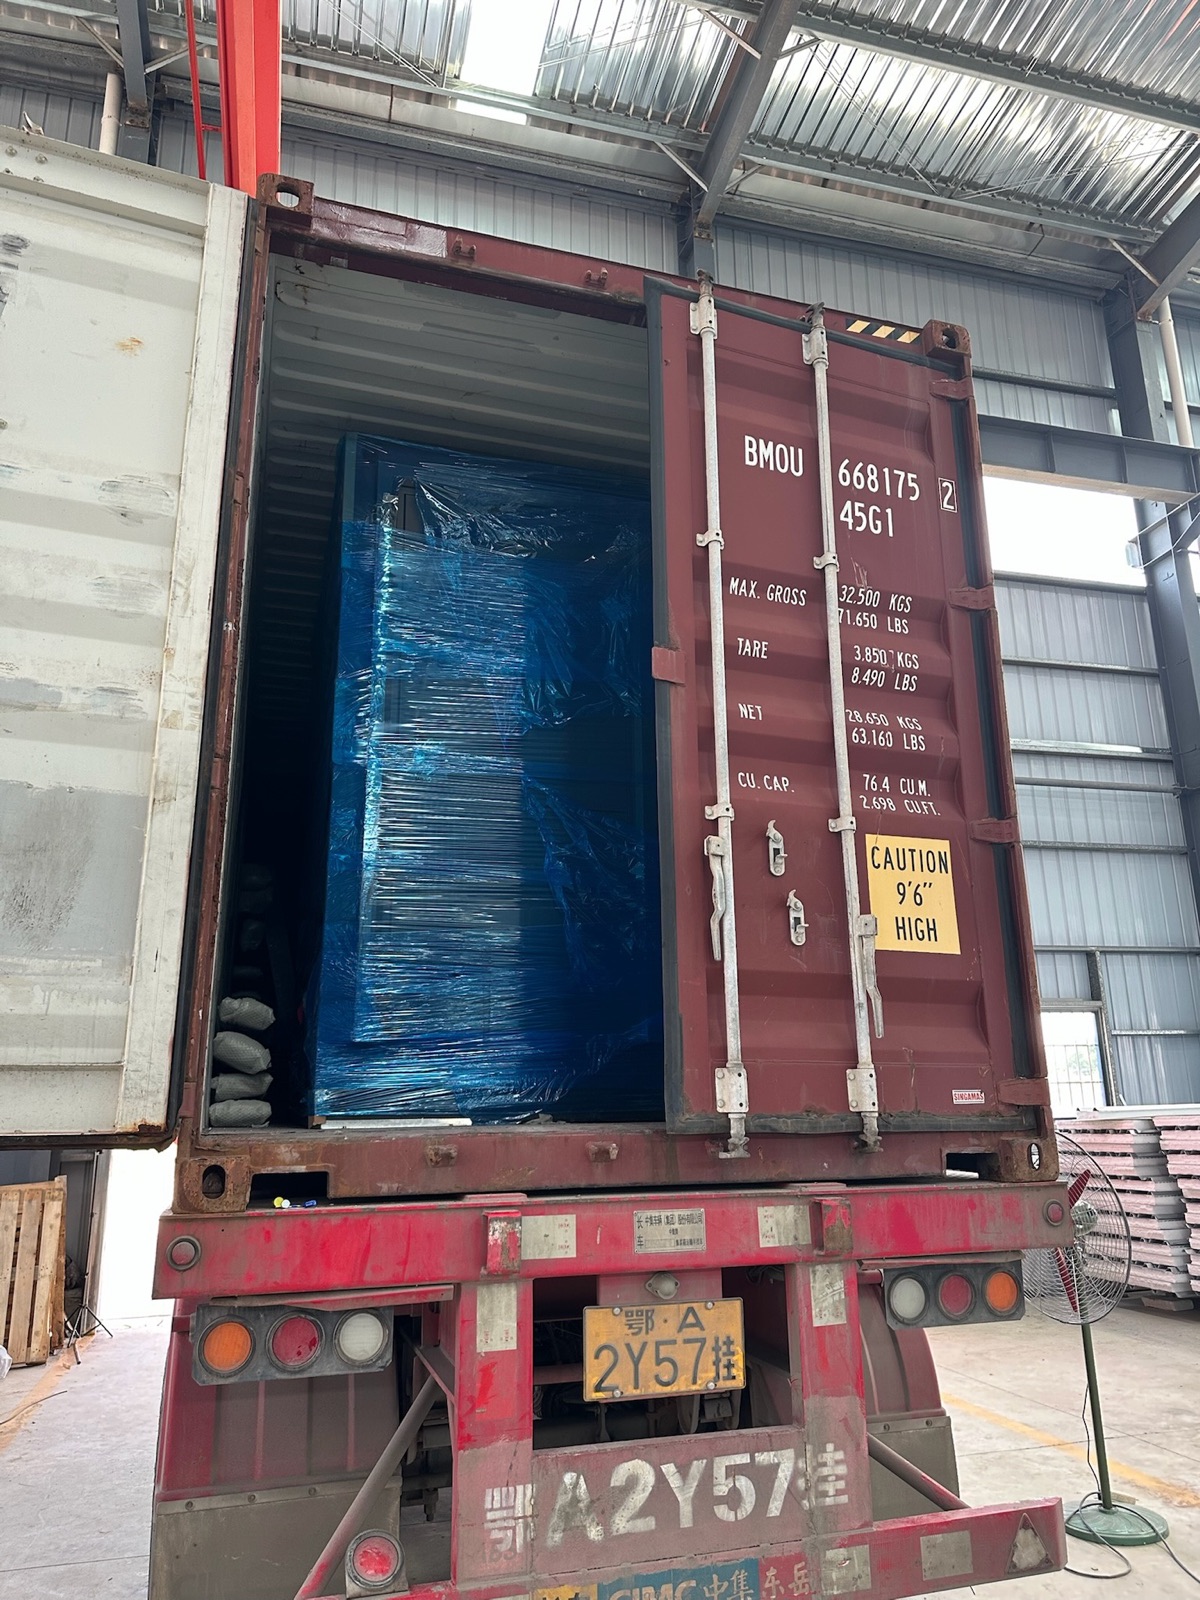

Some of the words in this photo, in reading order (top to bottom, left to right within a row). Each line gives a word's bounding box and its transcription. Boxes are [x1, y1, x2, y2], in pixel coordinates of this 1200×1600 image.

[744, 435, 803, 477] BMOU
[838, 458, 920, 501] 668175
[942, 481, 954, 509] 2
[839, 501, 894, 537] 45G1
[729, 577, 760, 599] MAX.
[766, 584, 807, 607] GROSS
[889, 593, 912, 613] KGS
[887, 616, 909, 635] LBS
[737, 637, 768, 660] TARE
[897, 652, 920, 670] KGS
[894, 673, 917, 692] LBS
[738, 703, 763, 721] NET
[897, 715, 922, 731] KGS
[903, 733, 926, 752] LBS
[862, 773, 890, 792] 76.4
[871, 845, 949, 875] CAUTION
[895, 916, 938, 942] HIGH
[953, 1092, 984, 1101] SINGAMAS
[593, 1335, 737, 1393] 2Y57挂
